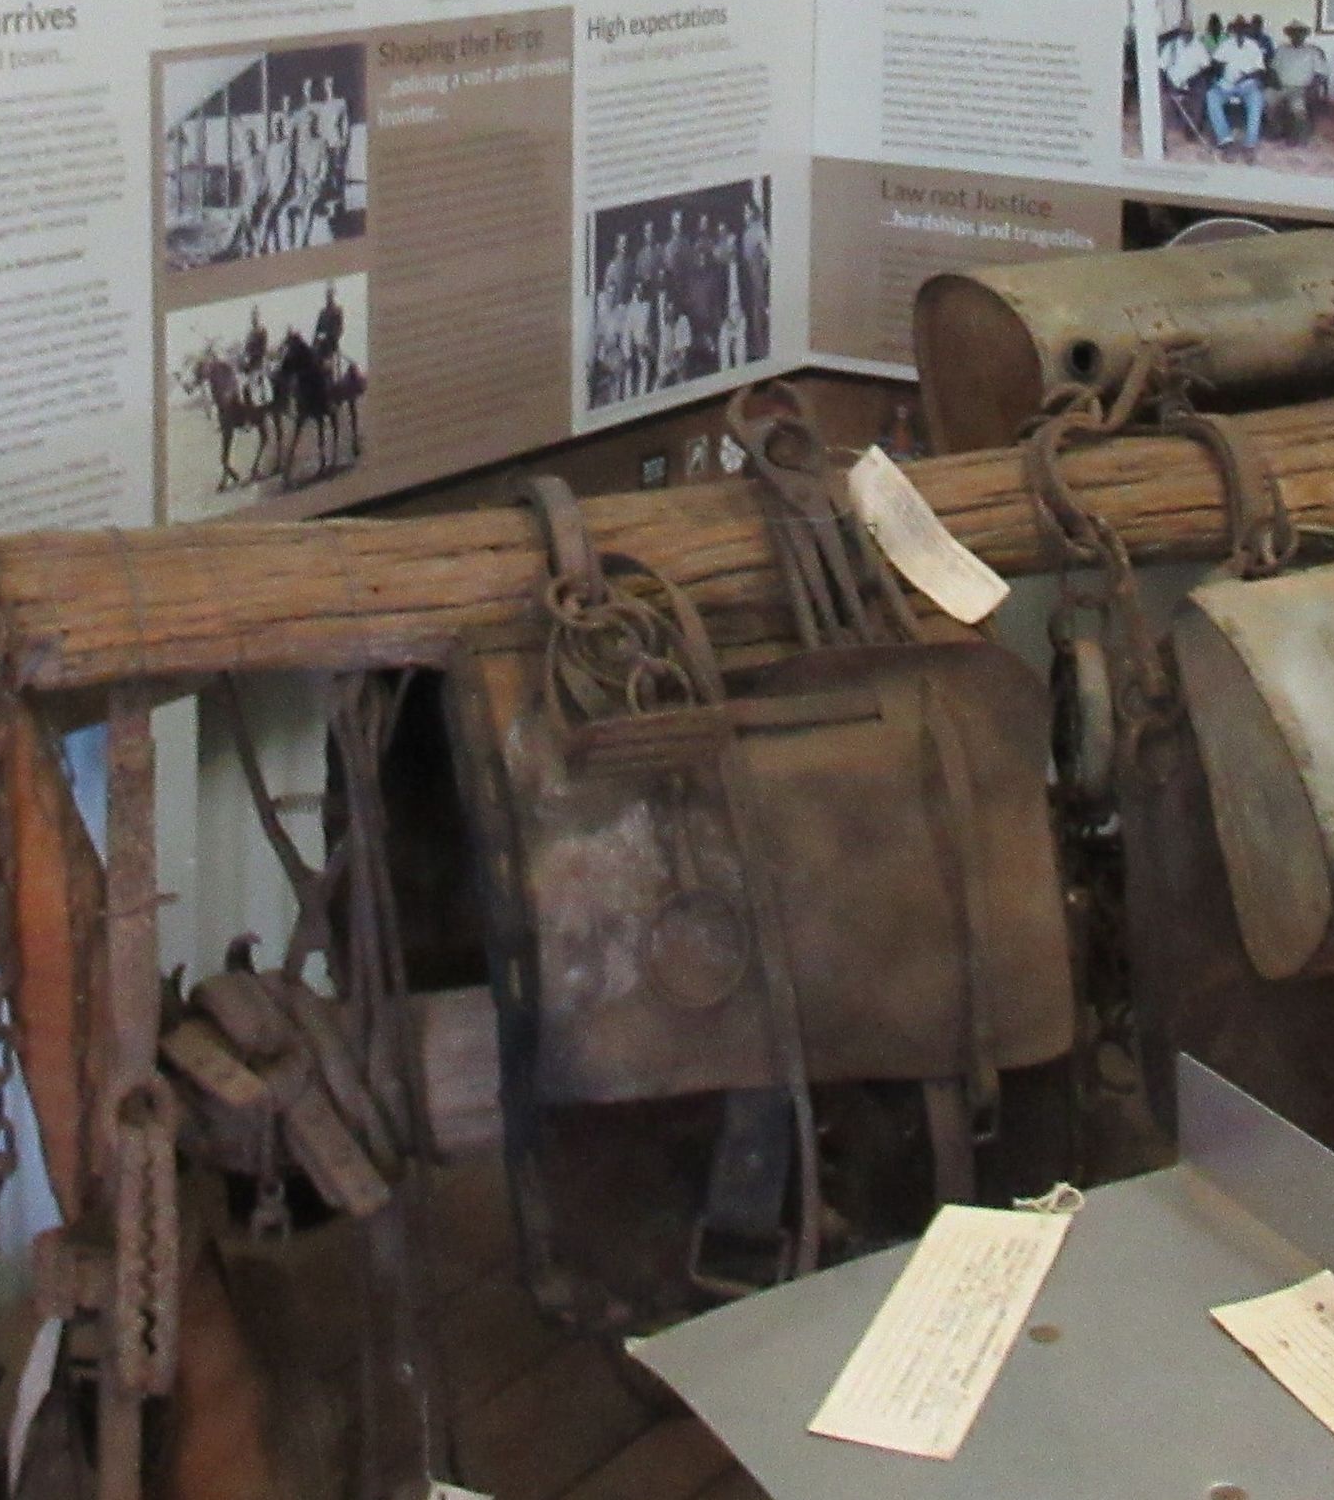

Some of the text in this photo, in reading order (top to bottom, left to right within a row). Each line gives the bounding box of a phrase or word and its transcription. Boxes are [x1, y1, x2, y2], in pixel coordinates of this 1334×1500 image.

[586, 4, 728, 45] High expectations
[378, 28, 544, 67] Shaping the Force
[879, 176, 1053, 219] Law not Justice
